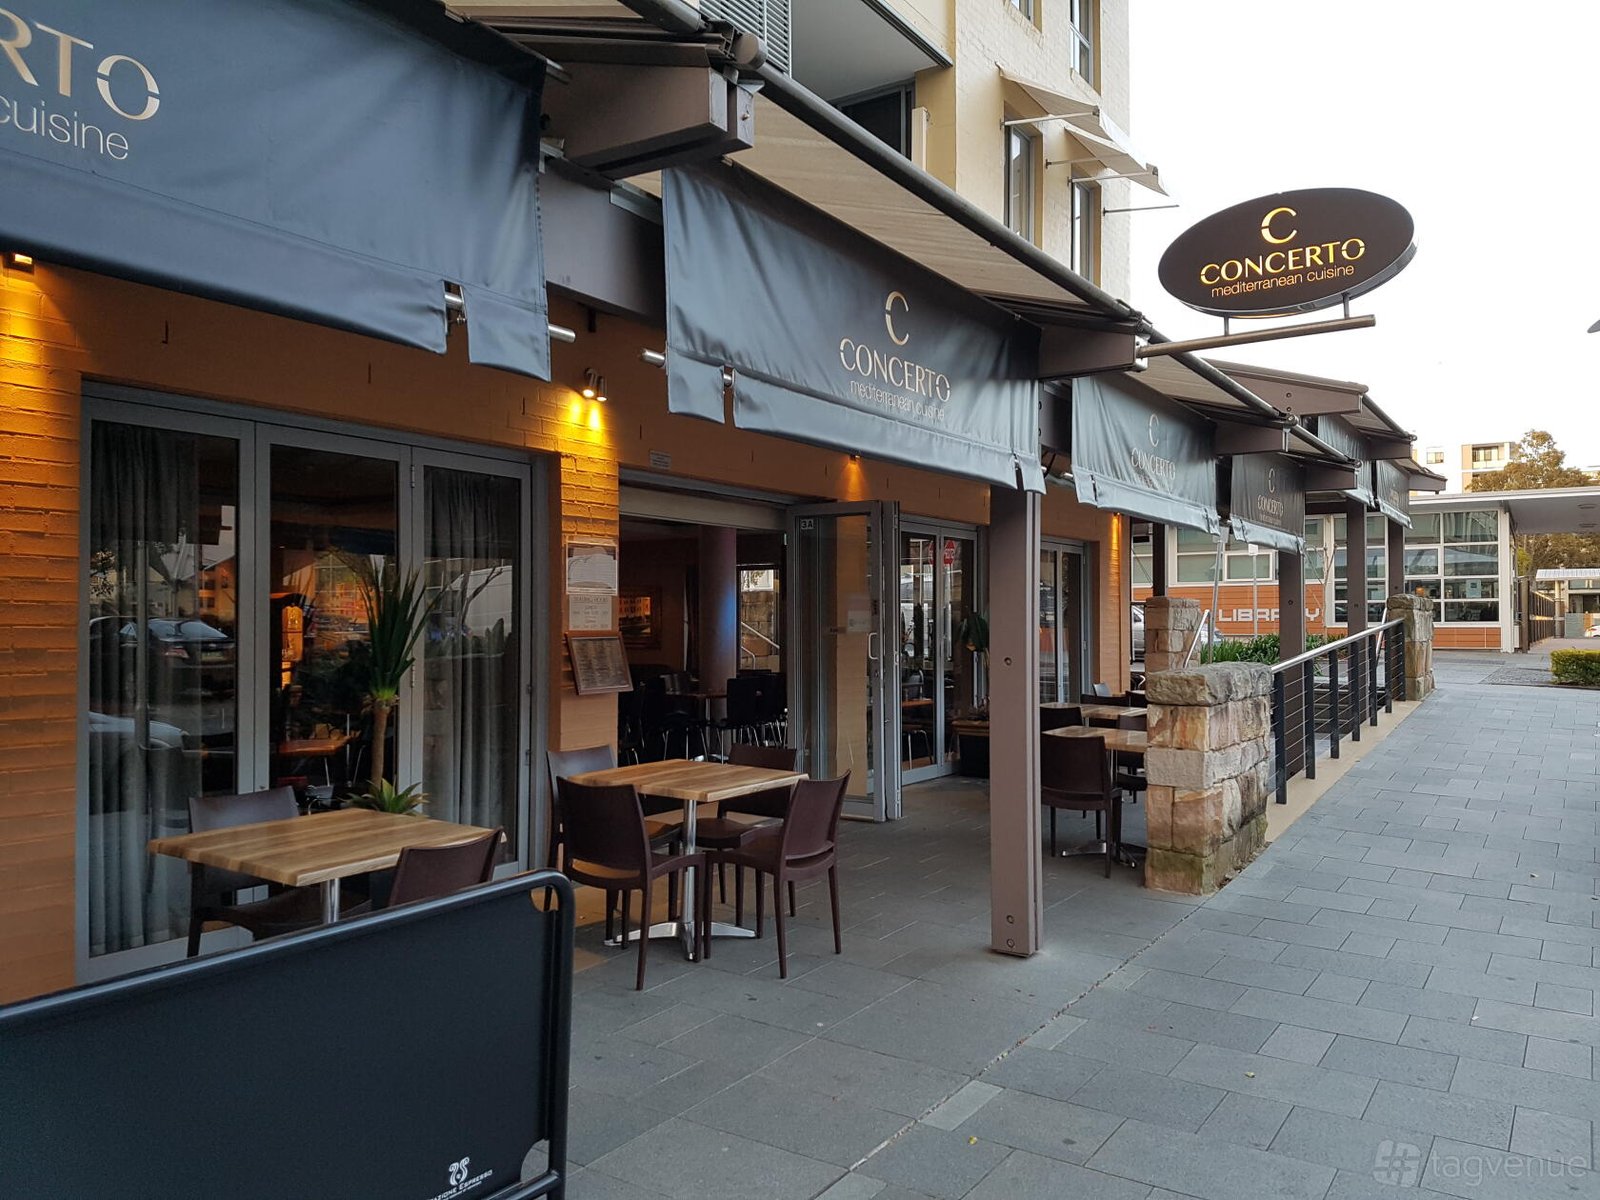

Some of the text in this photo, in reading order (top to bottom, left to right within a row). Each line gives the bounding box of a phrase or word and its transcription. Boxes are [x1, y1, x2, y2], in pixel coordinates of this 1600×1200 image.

[1260, 206, 1297, 244] C
[1200, 238, 1366, 285] CONCERTO
[1211, 264, 1355, 298] mediterranean cuisine
[885, 291, 909, 346] C
[839, 338, 951, 403] CONCERTO
[850, 380, 914, 412] mediterranean
[1131, 447, 1176, 480] CONCERTO
